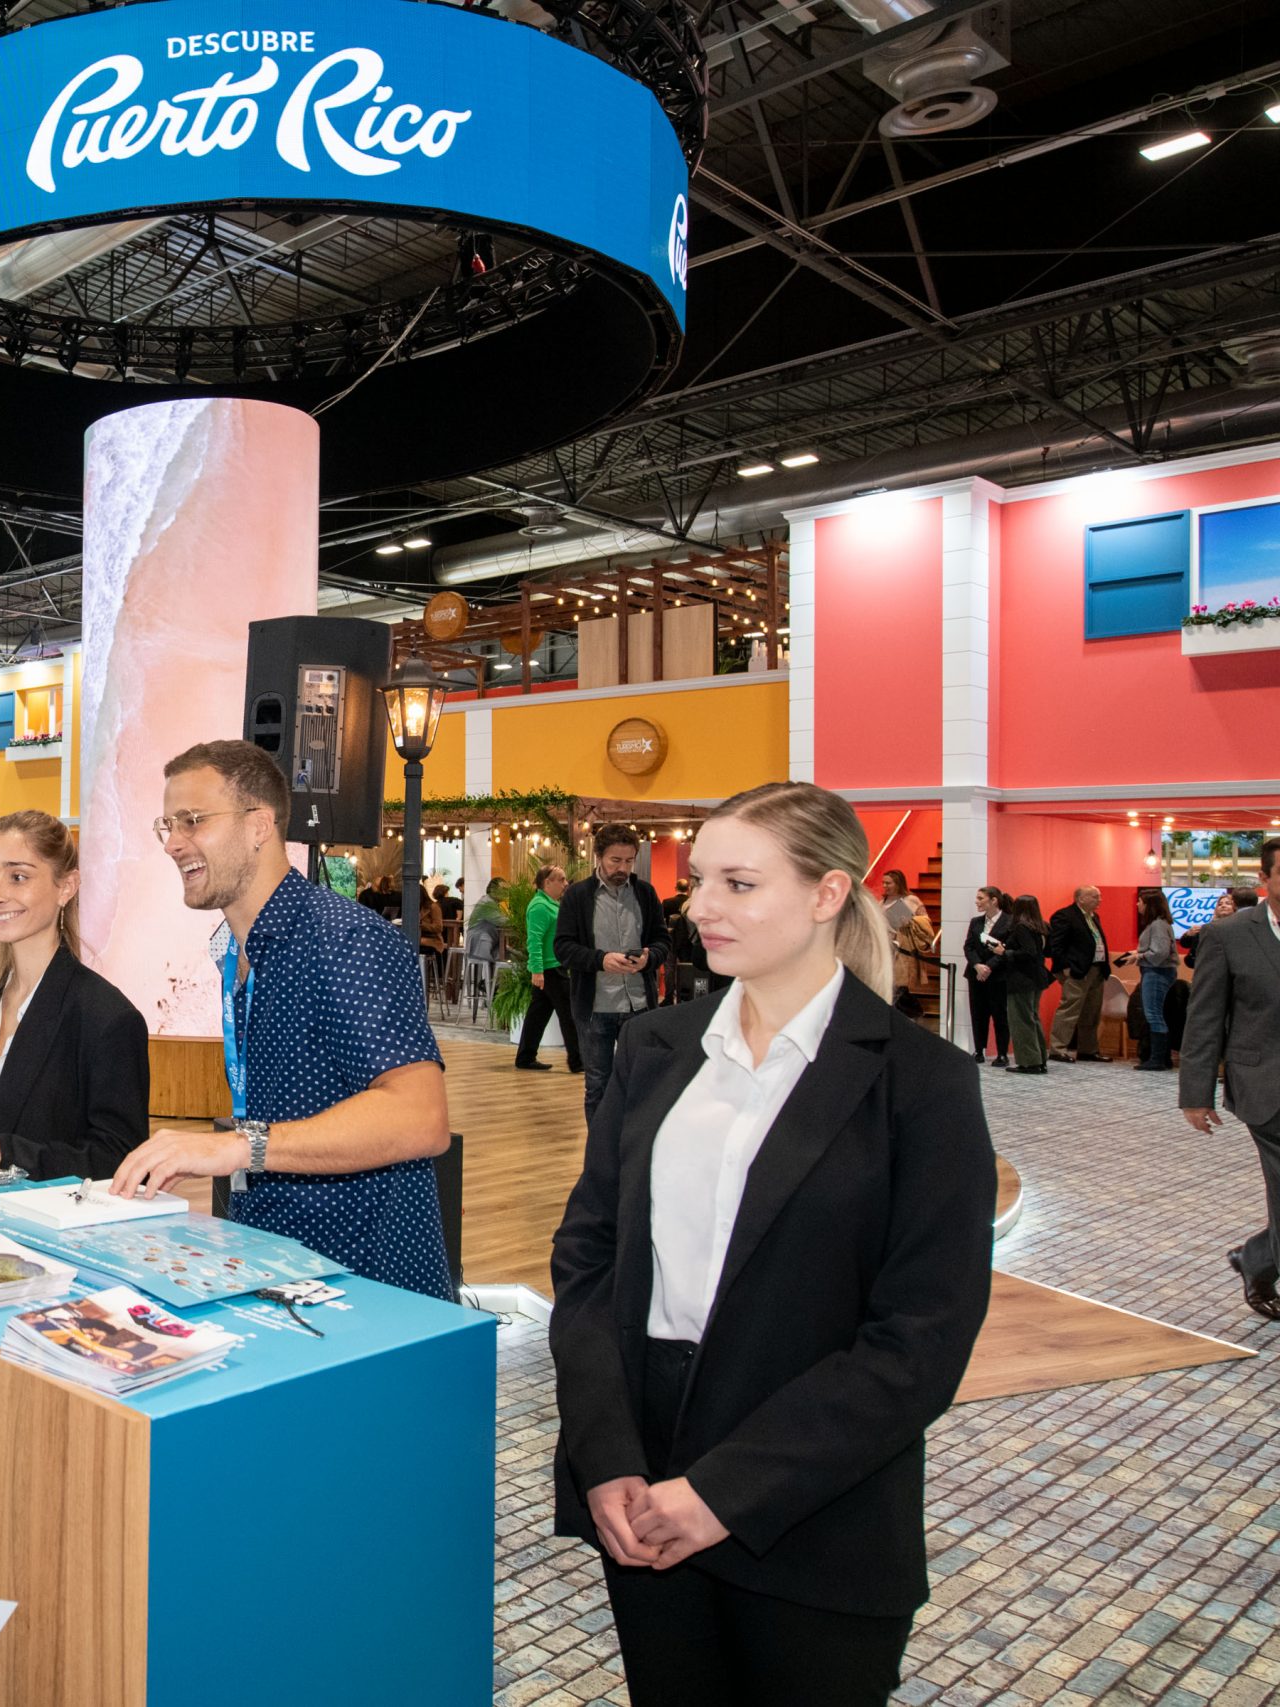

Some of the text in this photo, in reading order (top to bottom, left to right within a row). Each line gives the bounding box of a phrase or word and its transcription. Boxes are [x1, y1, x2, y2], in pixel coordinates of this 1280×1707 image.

[166, 30, 315, 59] DESCUBRE
[25, 47, 472, 194] Puerto Rico
[1171, 909, 1214, 930] Rico
[128, 1304, 196, 1339] SALSA
